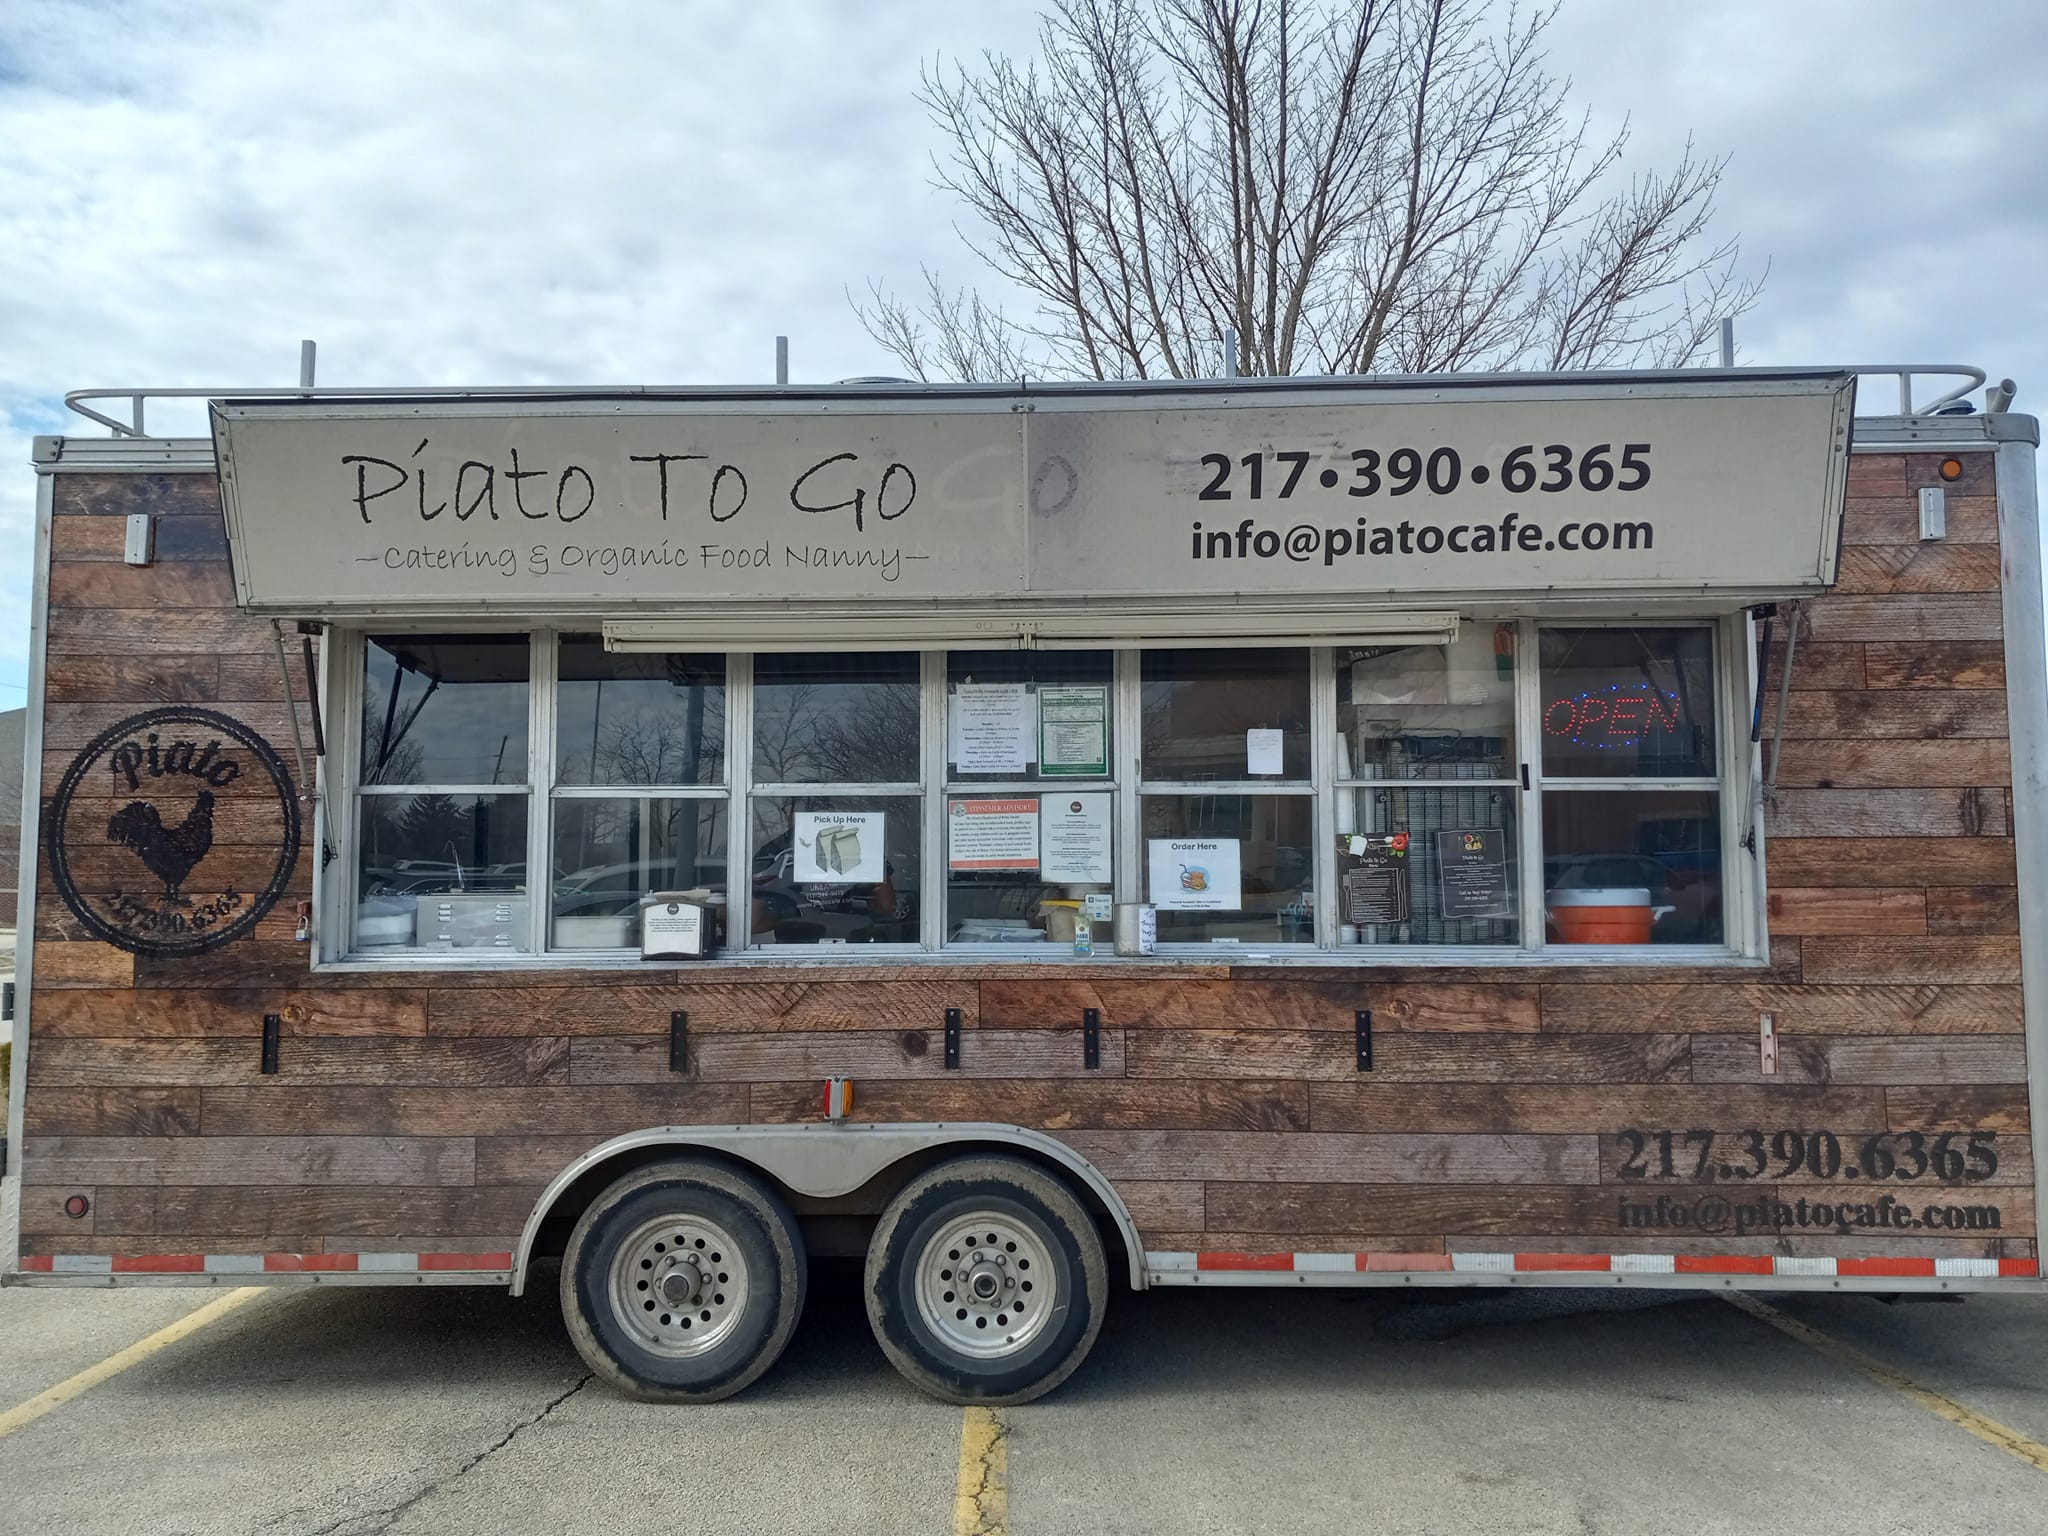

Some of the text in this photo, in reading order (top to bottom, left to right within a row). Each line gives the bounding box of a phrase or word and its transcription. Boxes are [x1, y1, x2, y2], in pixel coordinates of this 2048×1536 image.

[342, 438, 595, 523] Piato
[630, 450, 748, 522] To
[791, 453, 917, 532] Go
[1191, 512, 1654, 565] info@piatocafe.com
[528, 545, 549, 575] &
[560, 540, 689, 576] Organic
[699, 540, 771, 569] Food
[1545, 697, 1681, 735] OPEN
[833, 816, 845, 824] Up
[1171, 842, 1217, 850] Order Here
[1616, 1130, 1998, 1179] 217.390.6365
[1617, 1196, 2001, 1234] info@piatocafe.com
